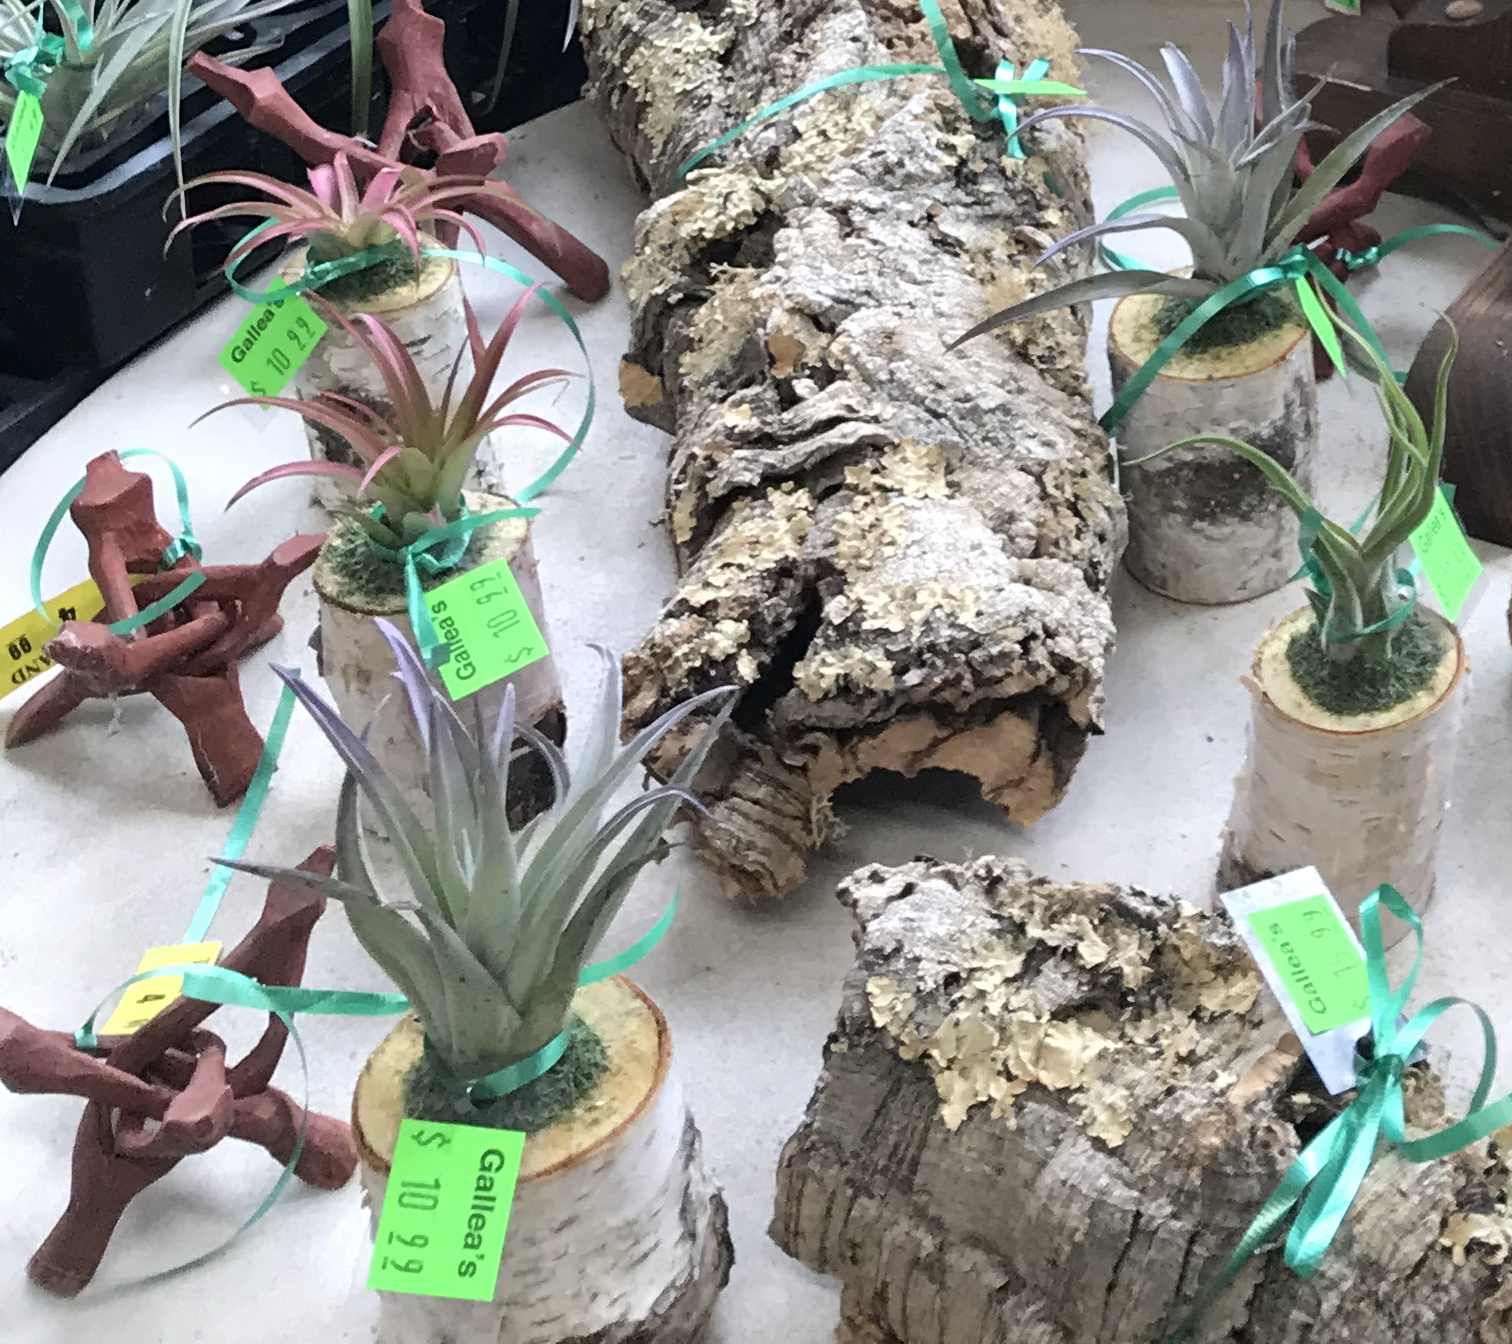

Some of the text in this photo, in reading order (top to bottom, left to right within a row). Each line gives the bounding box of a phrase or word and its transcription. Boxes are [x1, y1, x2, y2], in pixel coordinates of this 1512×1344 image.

[266, 347, 290, 375] 10
[286, 316, 315, 351] 99
[431, 599, 476, 680] Gallea's
[469, 571, 534, 663] $ 10 99
[1269, 922, 1327, 1014] Gallea's
[381, 1129, 451, 1274] $ 10 99
[457, 1148, 505, 1278] Gallea's
